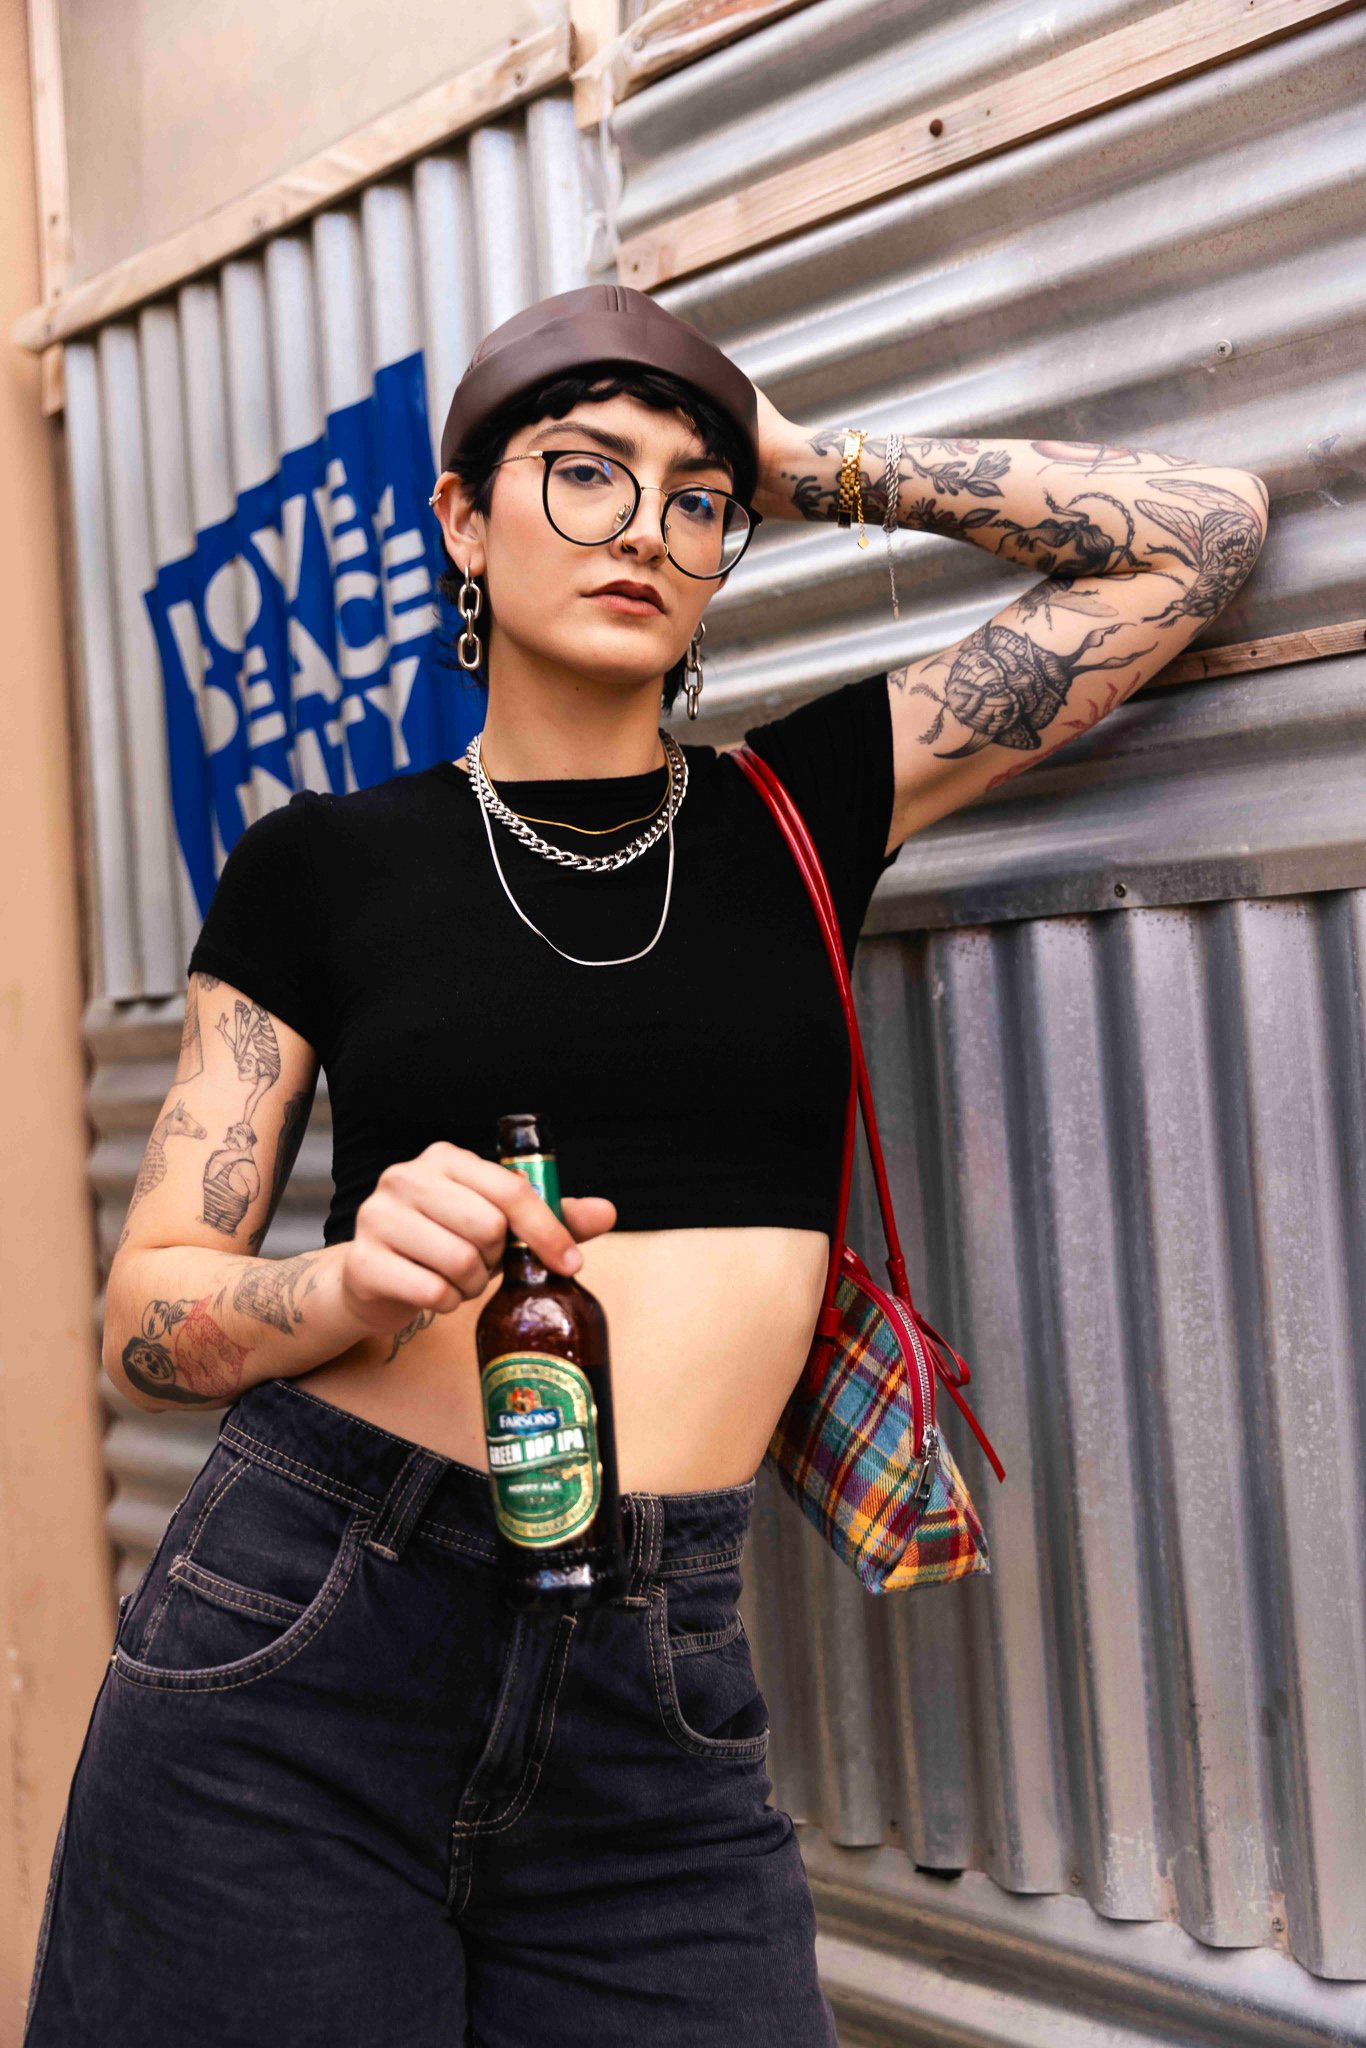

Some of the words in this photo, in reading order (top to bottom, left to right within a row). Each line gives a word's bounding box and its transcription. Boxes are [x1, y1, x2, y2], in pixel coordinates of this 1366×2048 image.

[167, 457, 369, 690] LOVE
[499, 1411, 557, 1429] FARSONS
[489, 1442, 523, 1466] GREEN
[525, 1434, 555, 1461] HOP
[556, 1427, 585, 1453] IPA
[540, 1480, 562, 1491] ALE
